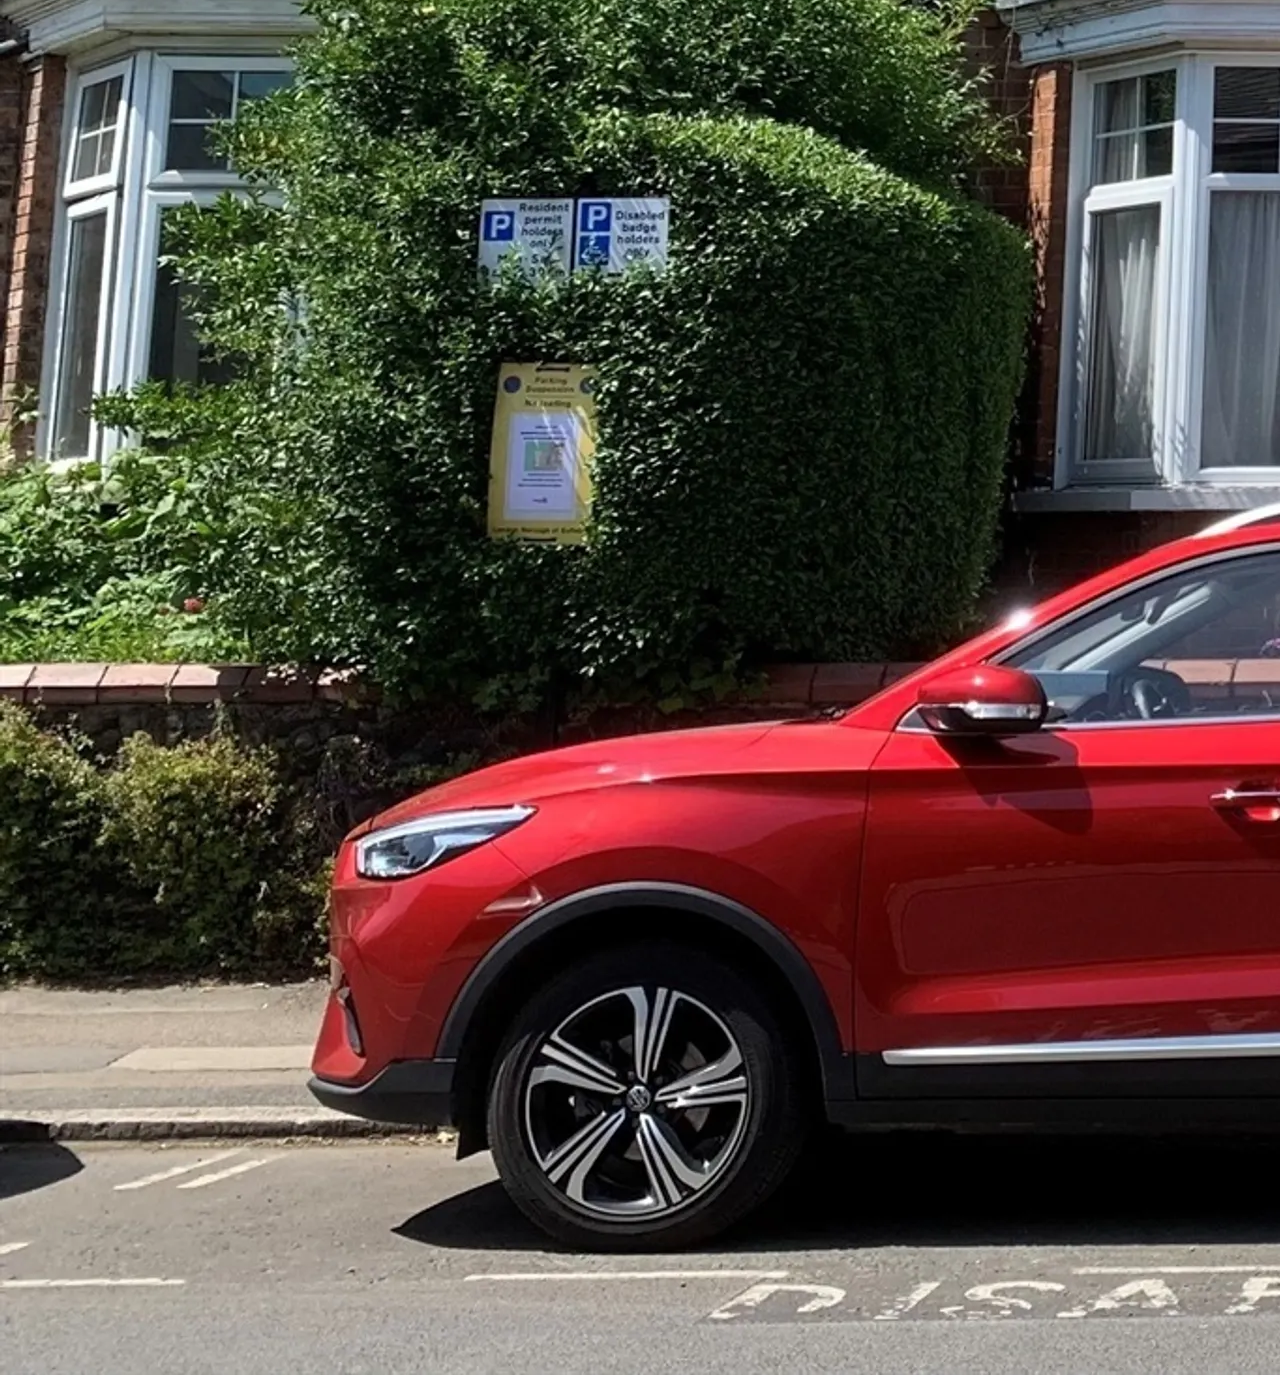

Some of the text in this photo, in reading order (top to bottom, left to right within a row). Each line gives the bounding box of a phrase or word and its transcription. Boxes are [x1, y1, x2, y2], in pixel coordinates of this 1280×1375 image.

[519, 202, 569, 212] Resident
[524, 215, 562, 227] permit
[588, 205, 608, 231] P
[615, 210, 664, 221] Disabled
[490, 214, 511, 238] P
[622, 223, 657, 234] badge
[616, 235, 660, 245] holders
[534, 376, 568, 386] Parking
